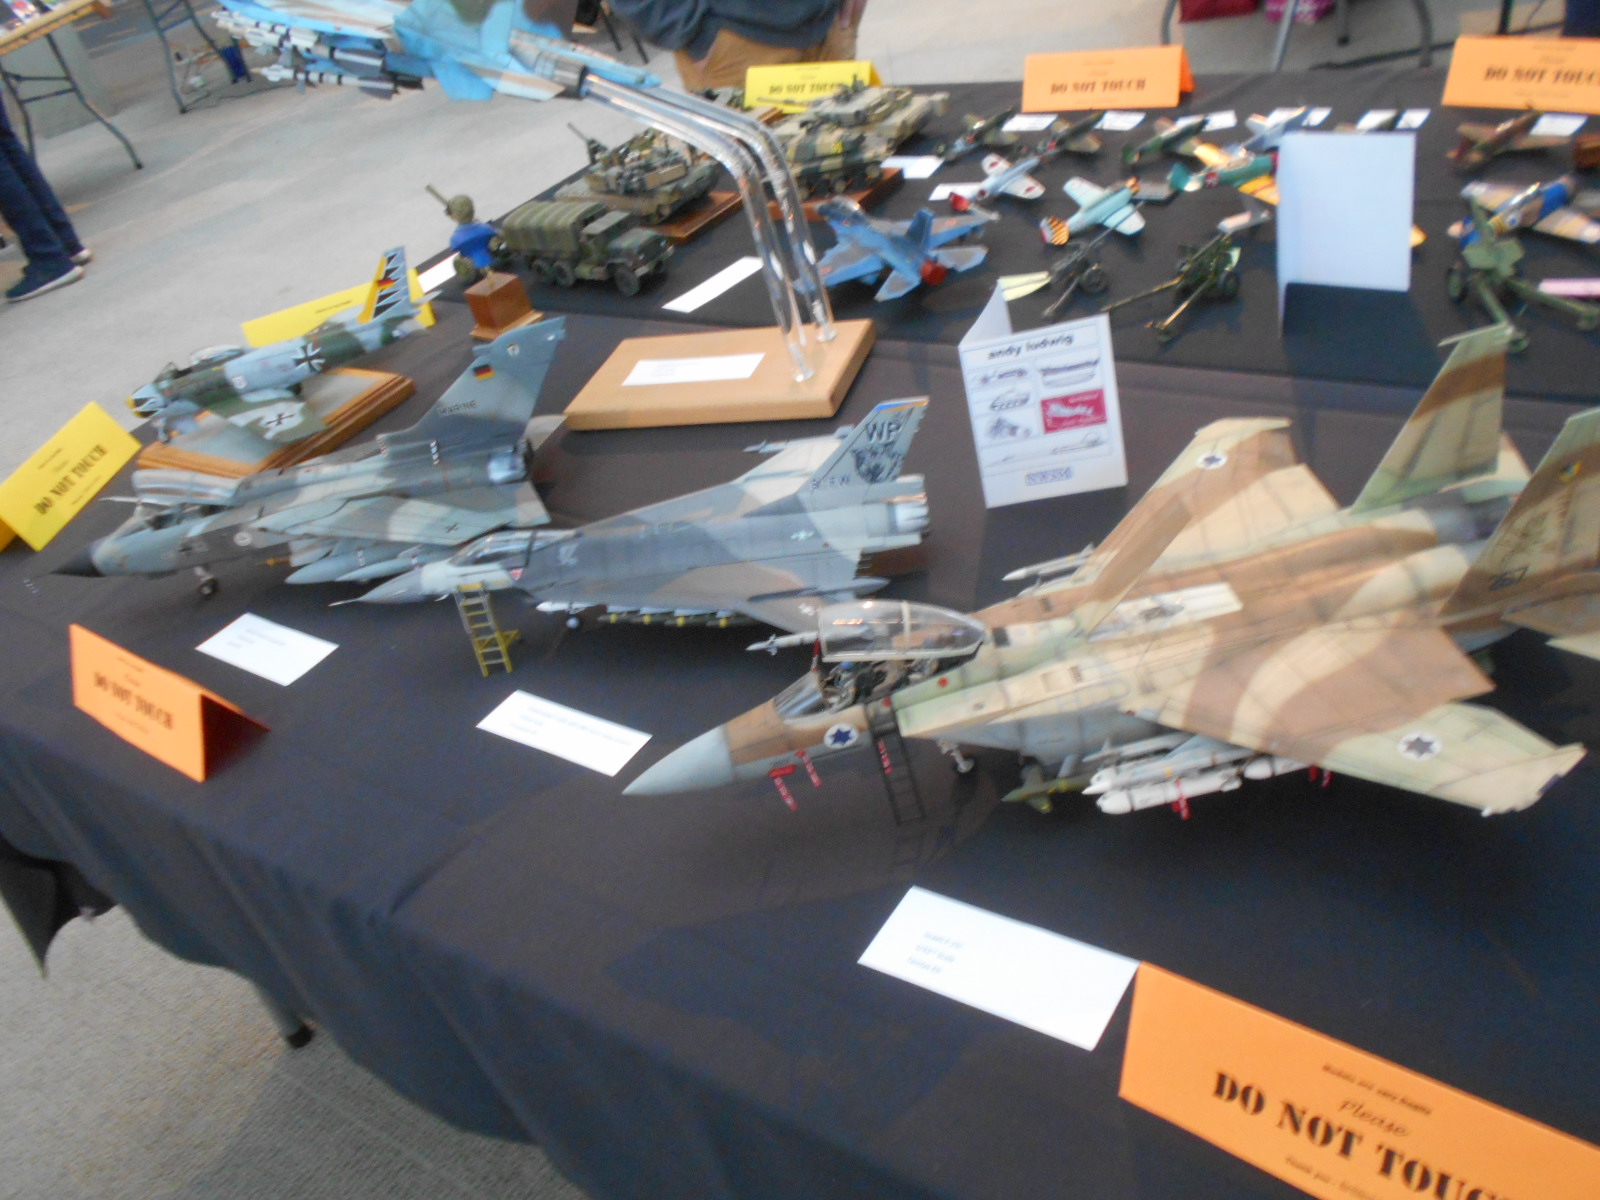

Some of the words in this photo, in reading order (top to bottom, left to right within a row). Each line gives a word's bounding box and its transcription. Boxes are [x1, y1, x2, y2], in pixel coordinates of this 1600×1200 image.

[1050, 82, 1068, 94] DO
[1072, 81, 1097, 93] NOT
[1102, 78, 1146, 92] TOUCH
[1485, 66, 1508, 81] DO
[1513, 67, 1547, 84] NOT
[1553, 69, 1600, 87] TOUC
[865, 420, 902, 443] WP
[71, 444, 109, 478] TOUCH
[1212, 1071, 1267, 1117] DO
[1275, 1100, 1364, 1160] NOT
[1338, 1099, 1410, 1138] Please
